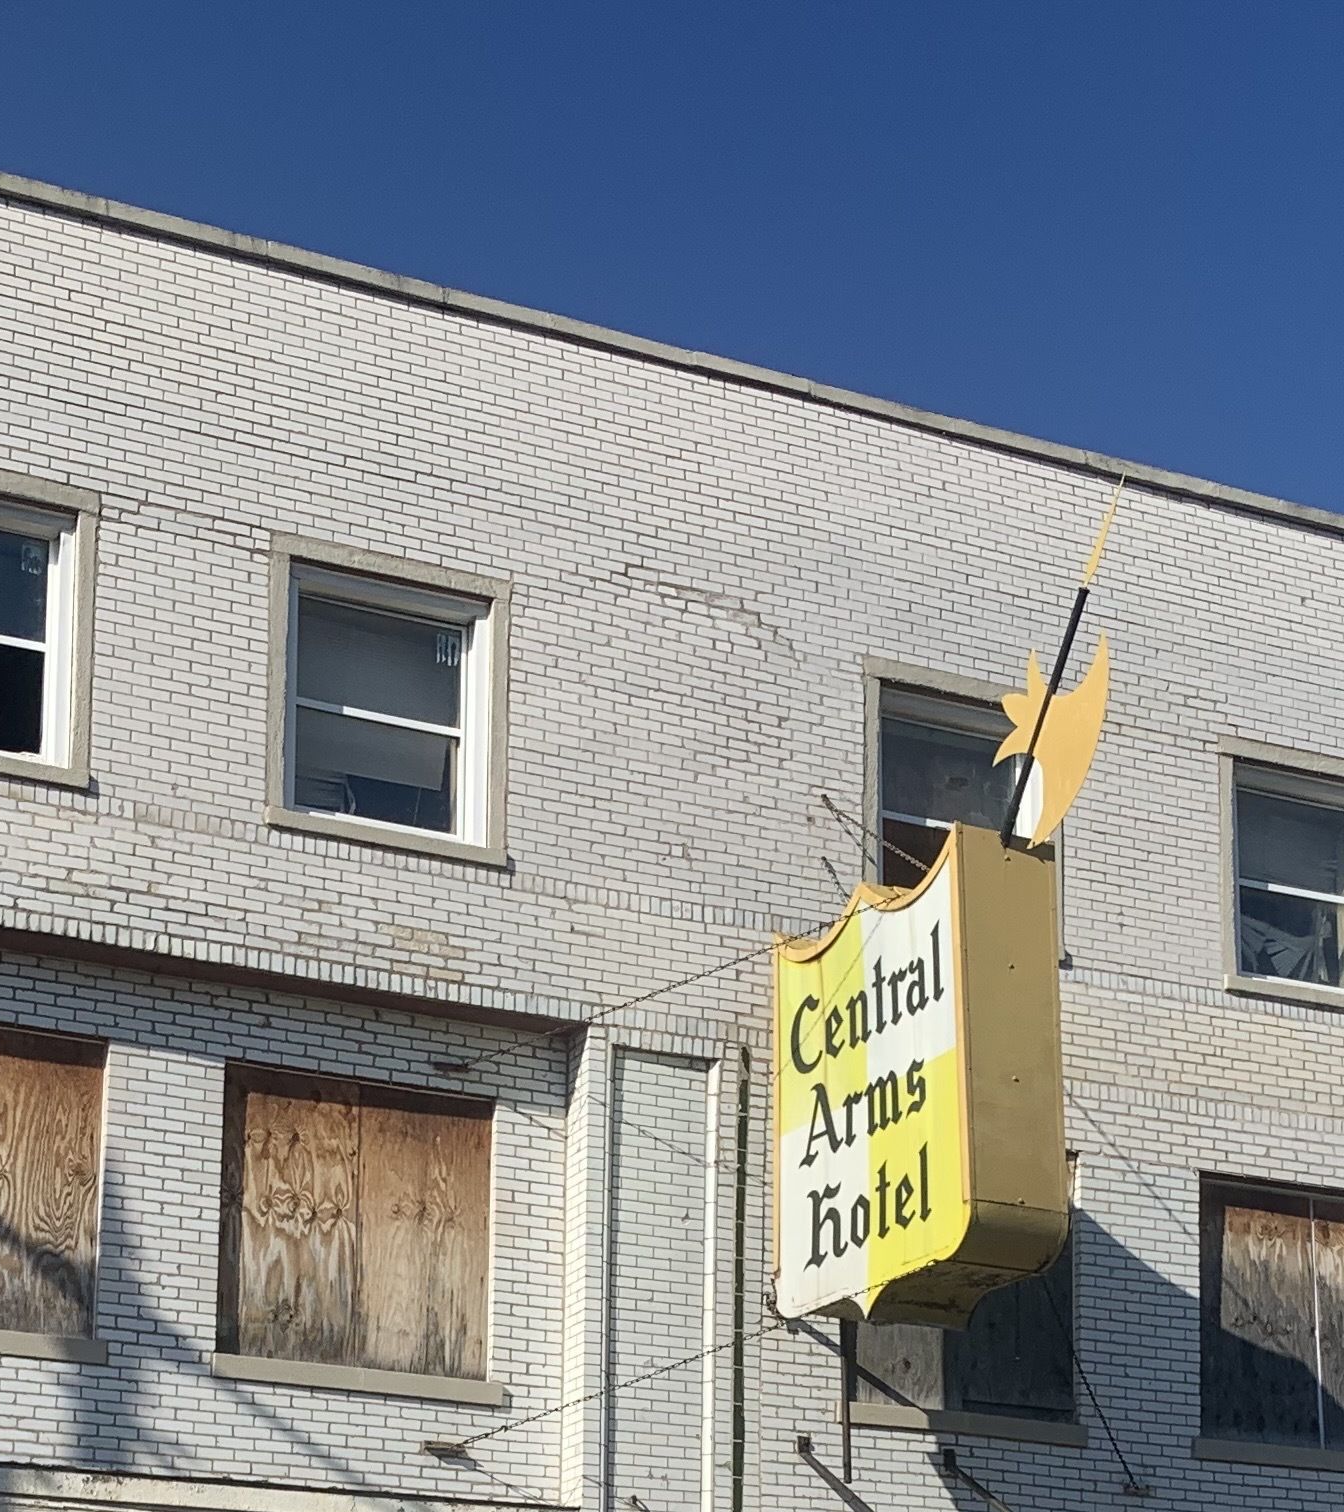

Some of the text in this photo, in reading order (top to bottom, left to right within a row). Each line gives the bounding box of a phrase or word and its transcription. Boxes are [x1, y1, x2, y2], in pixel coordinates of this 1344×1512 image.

[790, 920, 944, 1075] Central
[799, 1057, 926, 1168] Arms
[803, 1141, 931, 1272] Hotel
